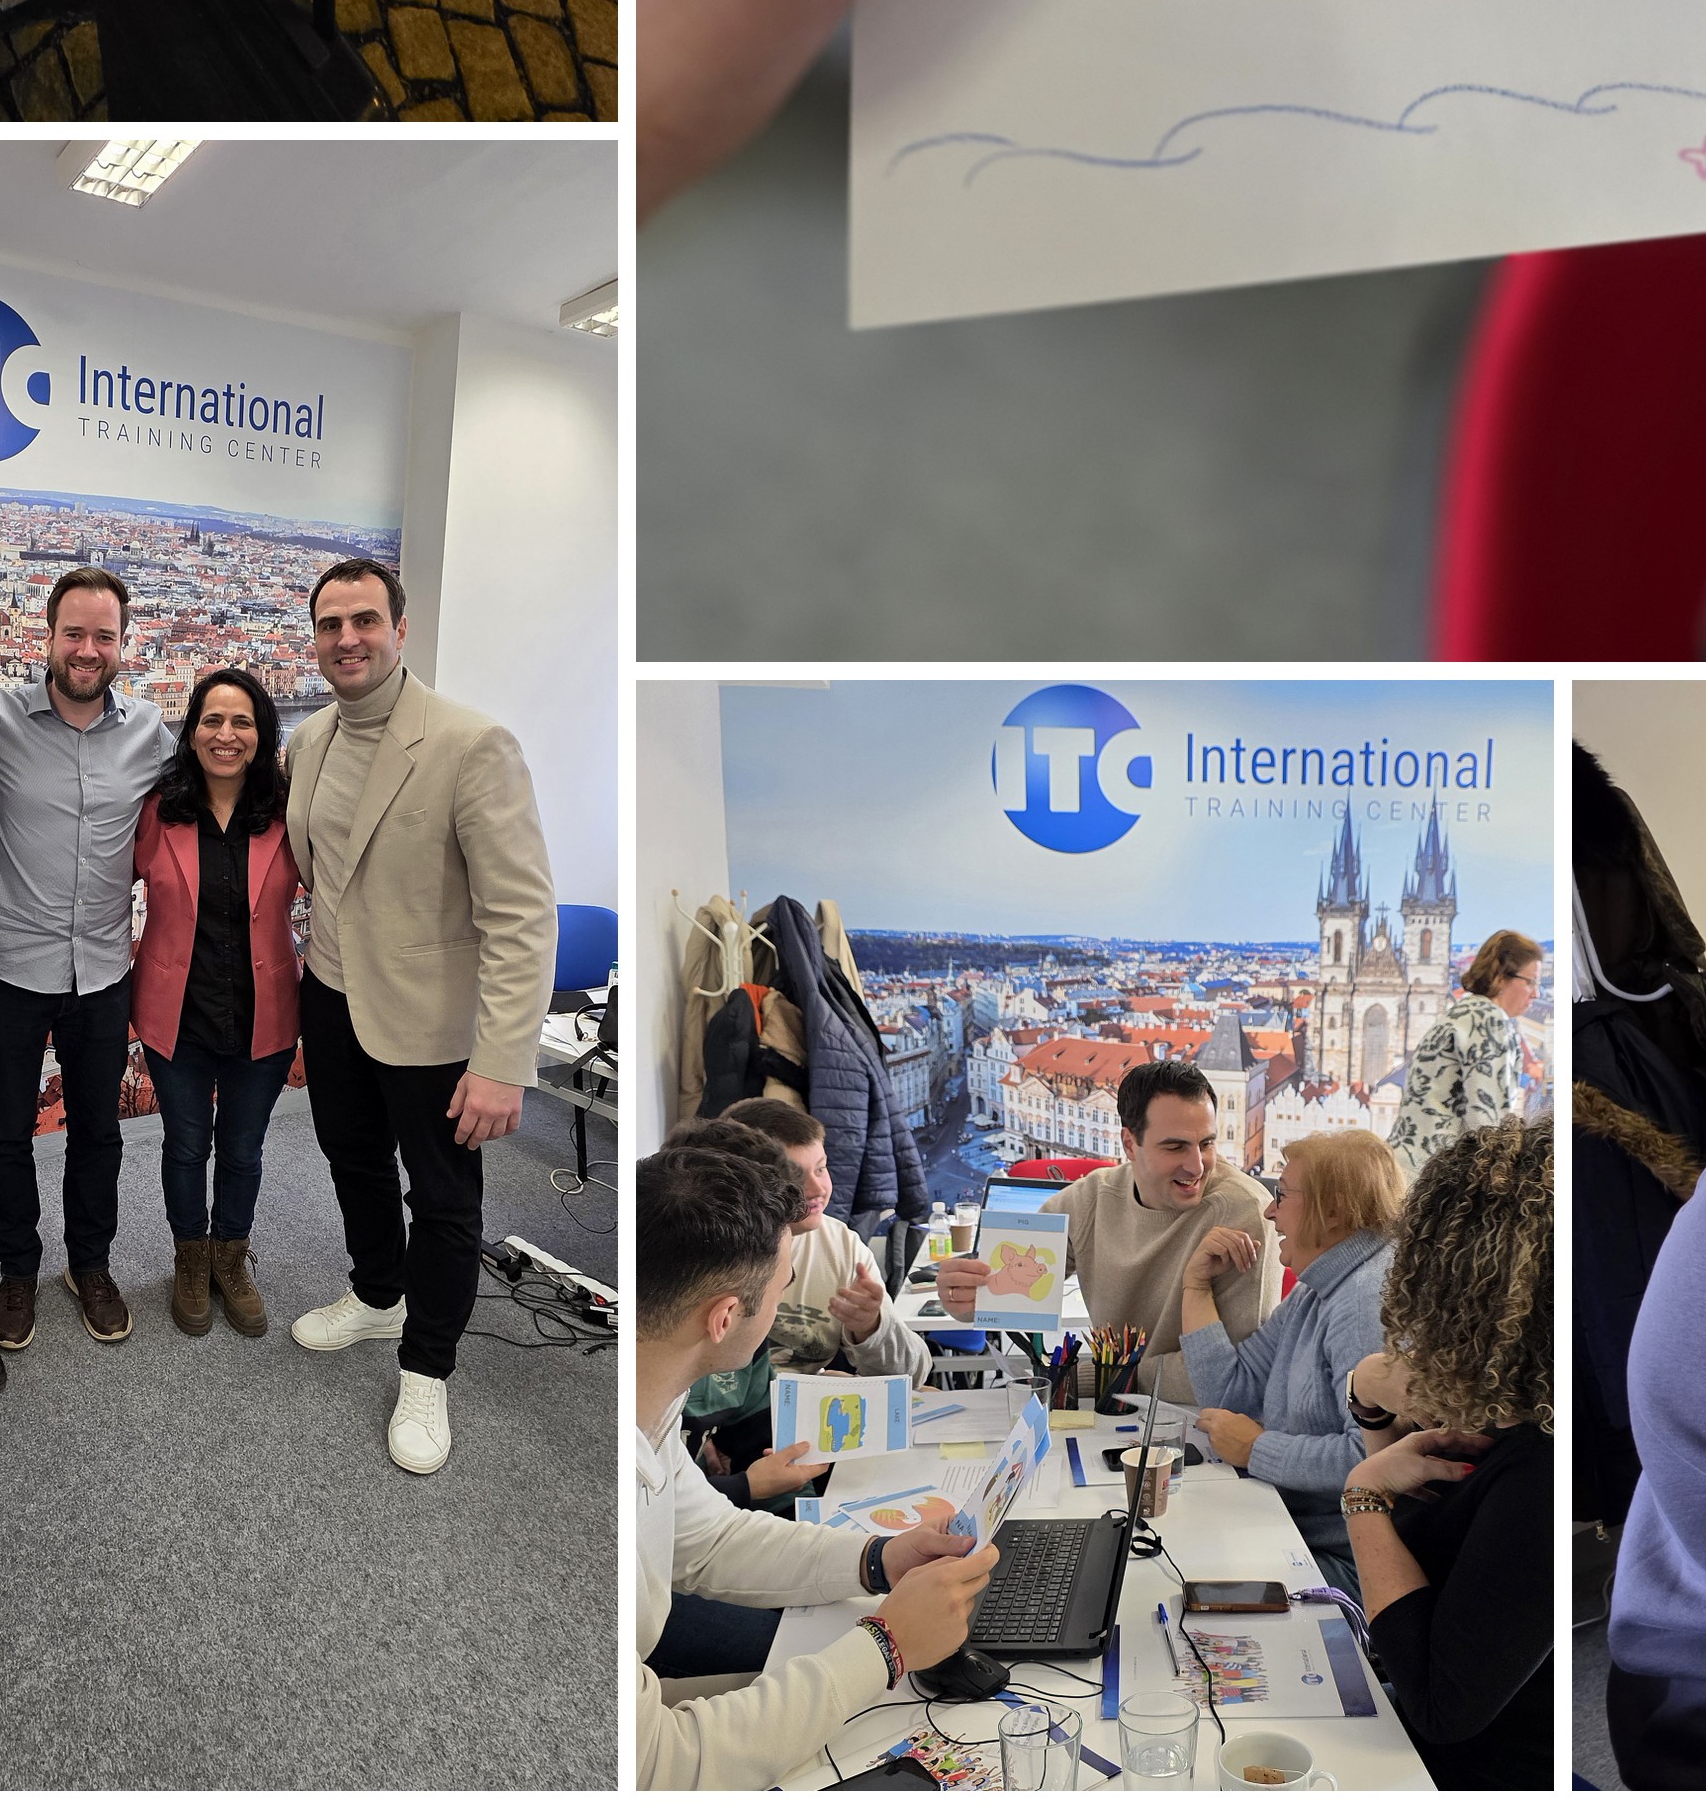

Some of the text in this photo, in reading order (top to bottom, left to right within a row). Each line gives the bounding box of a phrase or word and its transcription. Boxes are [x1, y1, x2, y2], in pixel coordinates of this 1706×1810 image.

[79, 354, 325, 441] International
[78, 417, 323, 470] TRAINING CENTER
[994, 725, 1153, 817] ITC
[1186, 731, 1494, 790] International
[1184, 795, 1492, 823] TRAINING CENTER
[977, 1316, 1000, 1324] NAME:
